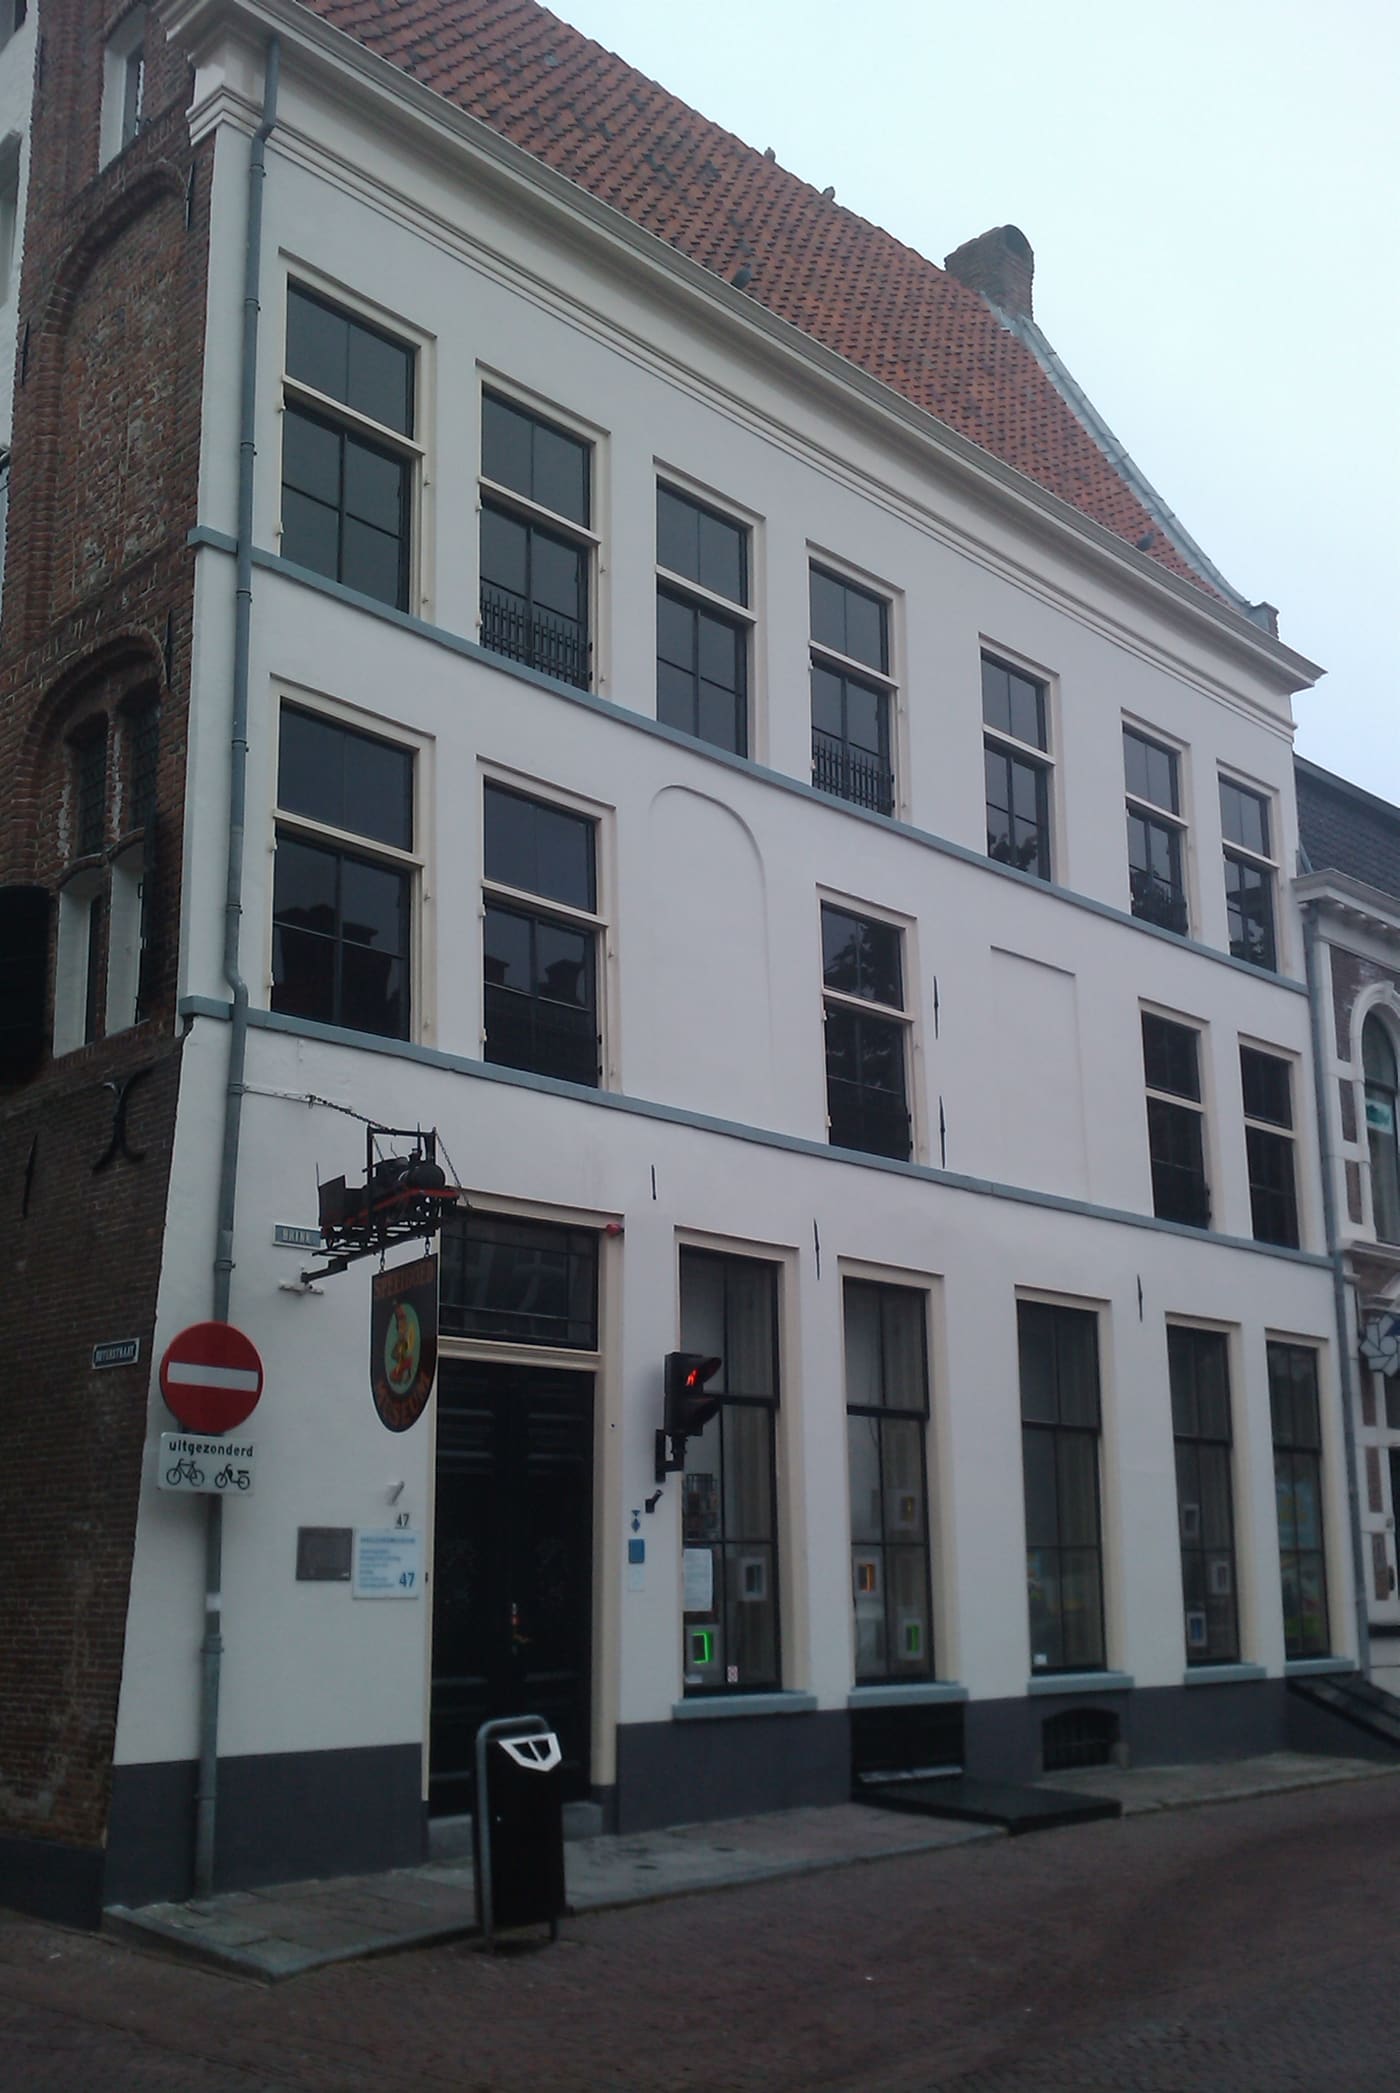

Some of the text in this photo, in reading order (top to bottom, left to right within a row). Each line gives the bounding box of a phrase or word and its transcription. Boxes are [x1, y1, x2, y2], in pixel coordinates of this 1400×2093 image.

[282, 1228, 313, 1244] BRINK
[168, 1439, 254, 1457] uitgezonderd
[396, 1512, 410, 1527] 47
[399, 1571, 415, 1588] 47
